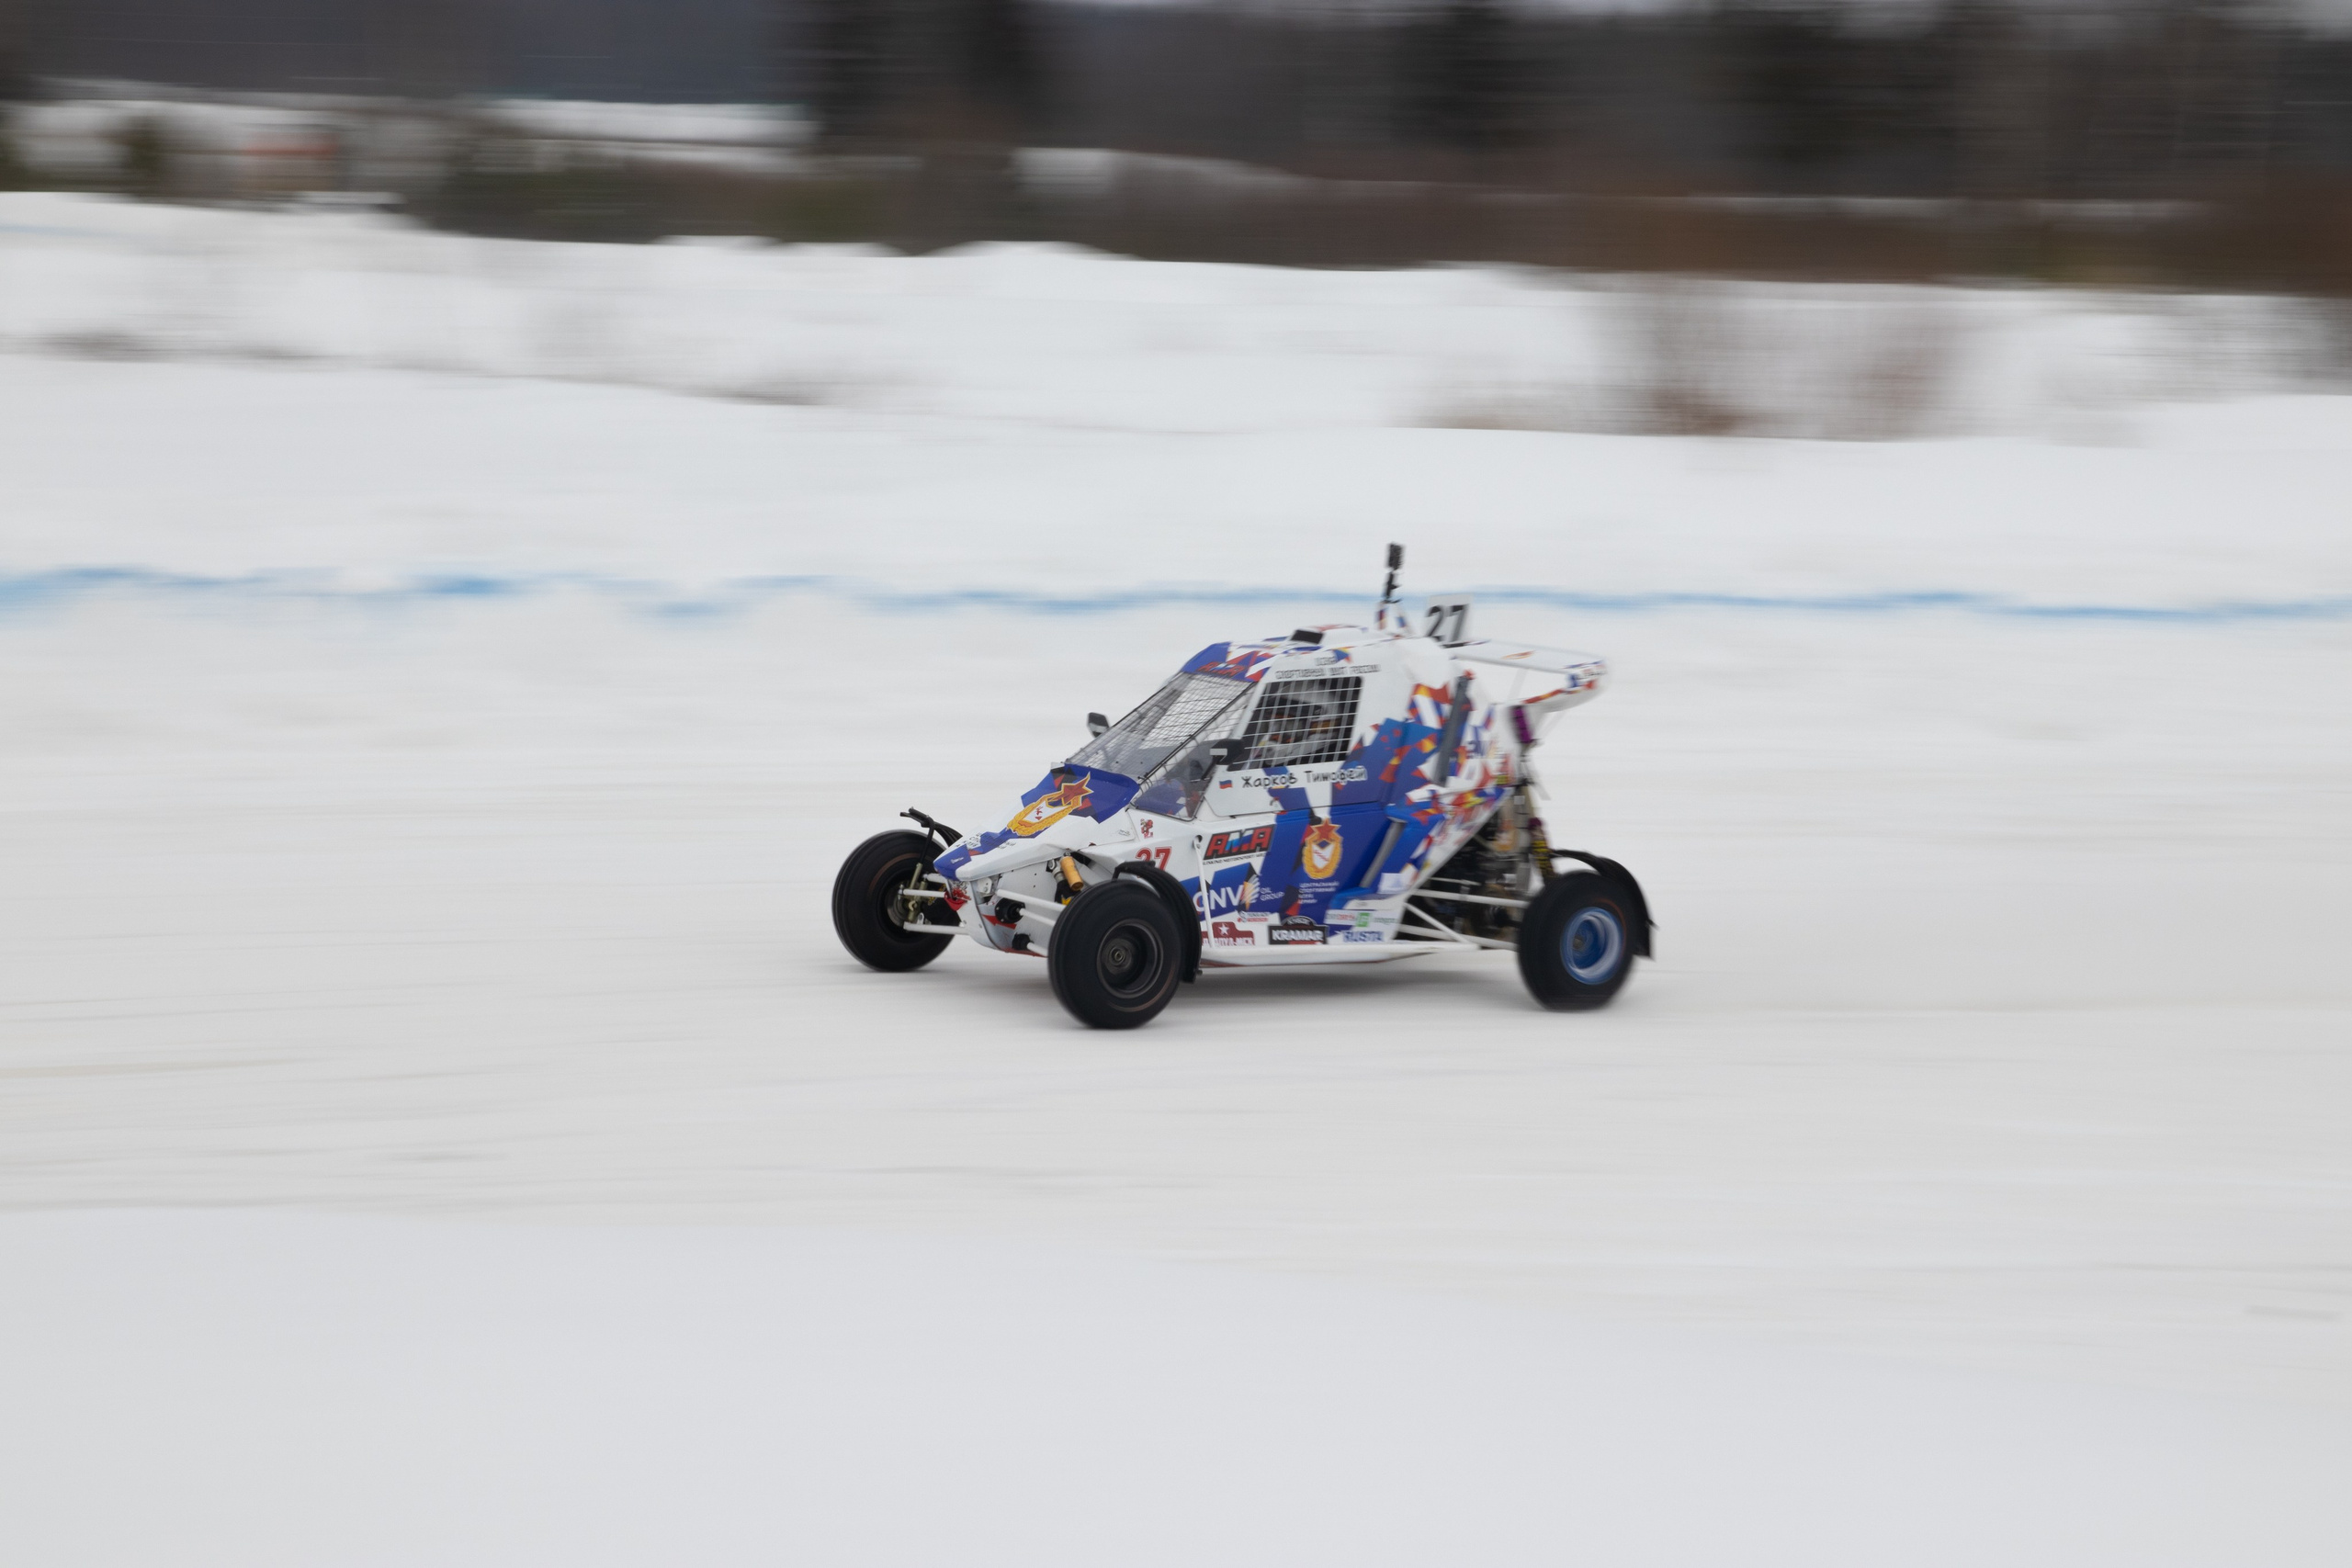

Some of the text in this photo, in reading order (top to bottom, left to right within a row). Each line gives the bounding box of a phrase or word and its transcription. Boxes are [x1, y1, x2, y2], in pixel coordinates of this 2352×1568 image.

[1426, 604, 1468, 642] 27
[1241, 766, 1367, 788] Жарков Тимофей
[1136, 846, 1172, 870] 27
[1272, 930, 1324, 941] KRAMAR
